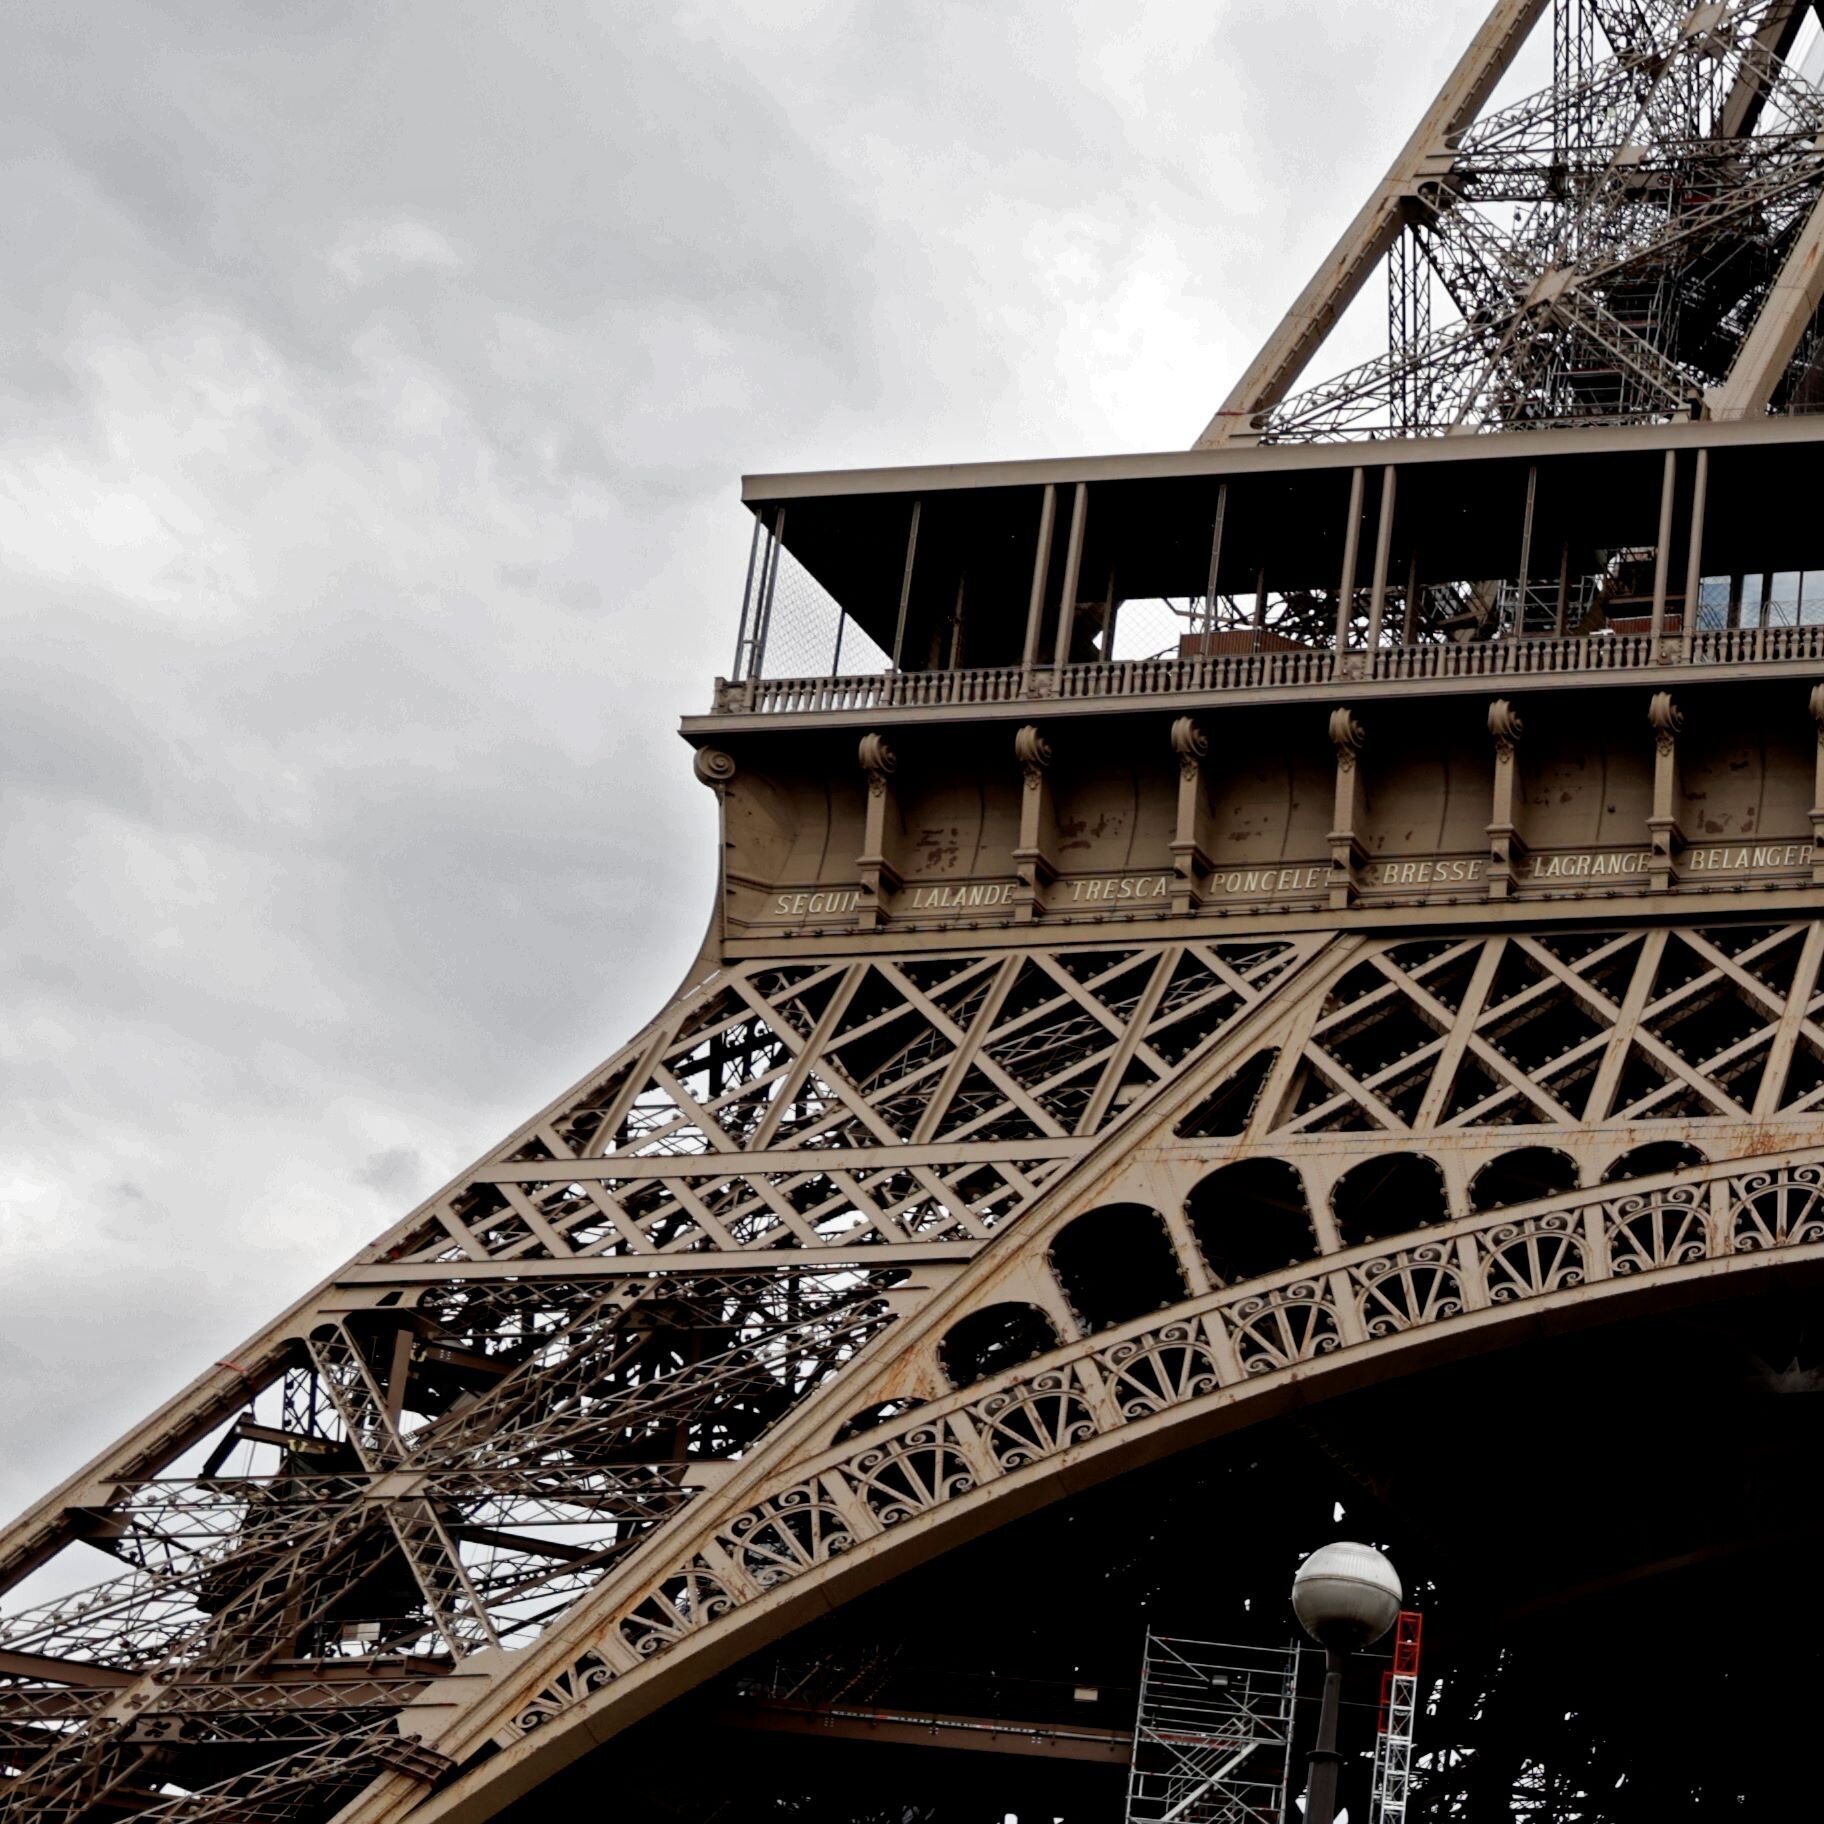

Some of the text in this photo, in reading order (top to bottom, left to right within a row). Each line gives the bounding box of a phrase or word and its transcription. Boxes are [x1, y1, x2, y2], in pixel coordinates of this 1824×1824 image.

[1533, 853, 1649, 878] LAGRANGE
[1689, 845, 1812, 871] BELANGER
[1383, 860, 1483, 884] BRESSE
[912, 883, 1016, 909] LALANDE
[1070, 877, 1168, 902] TRESCA
